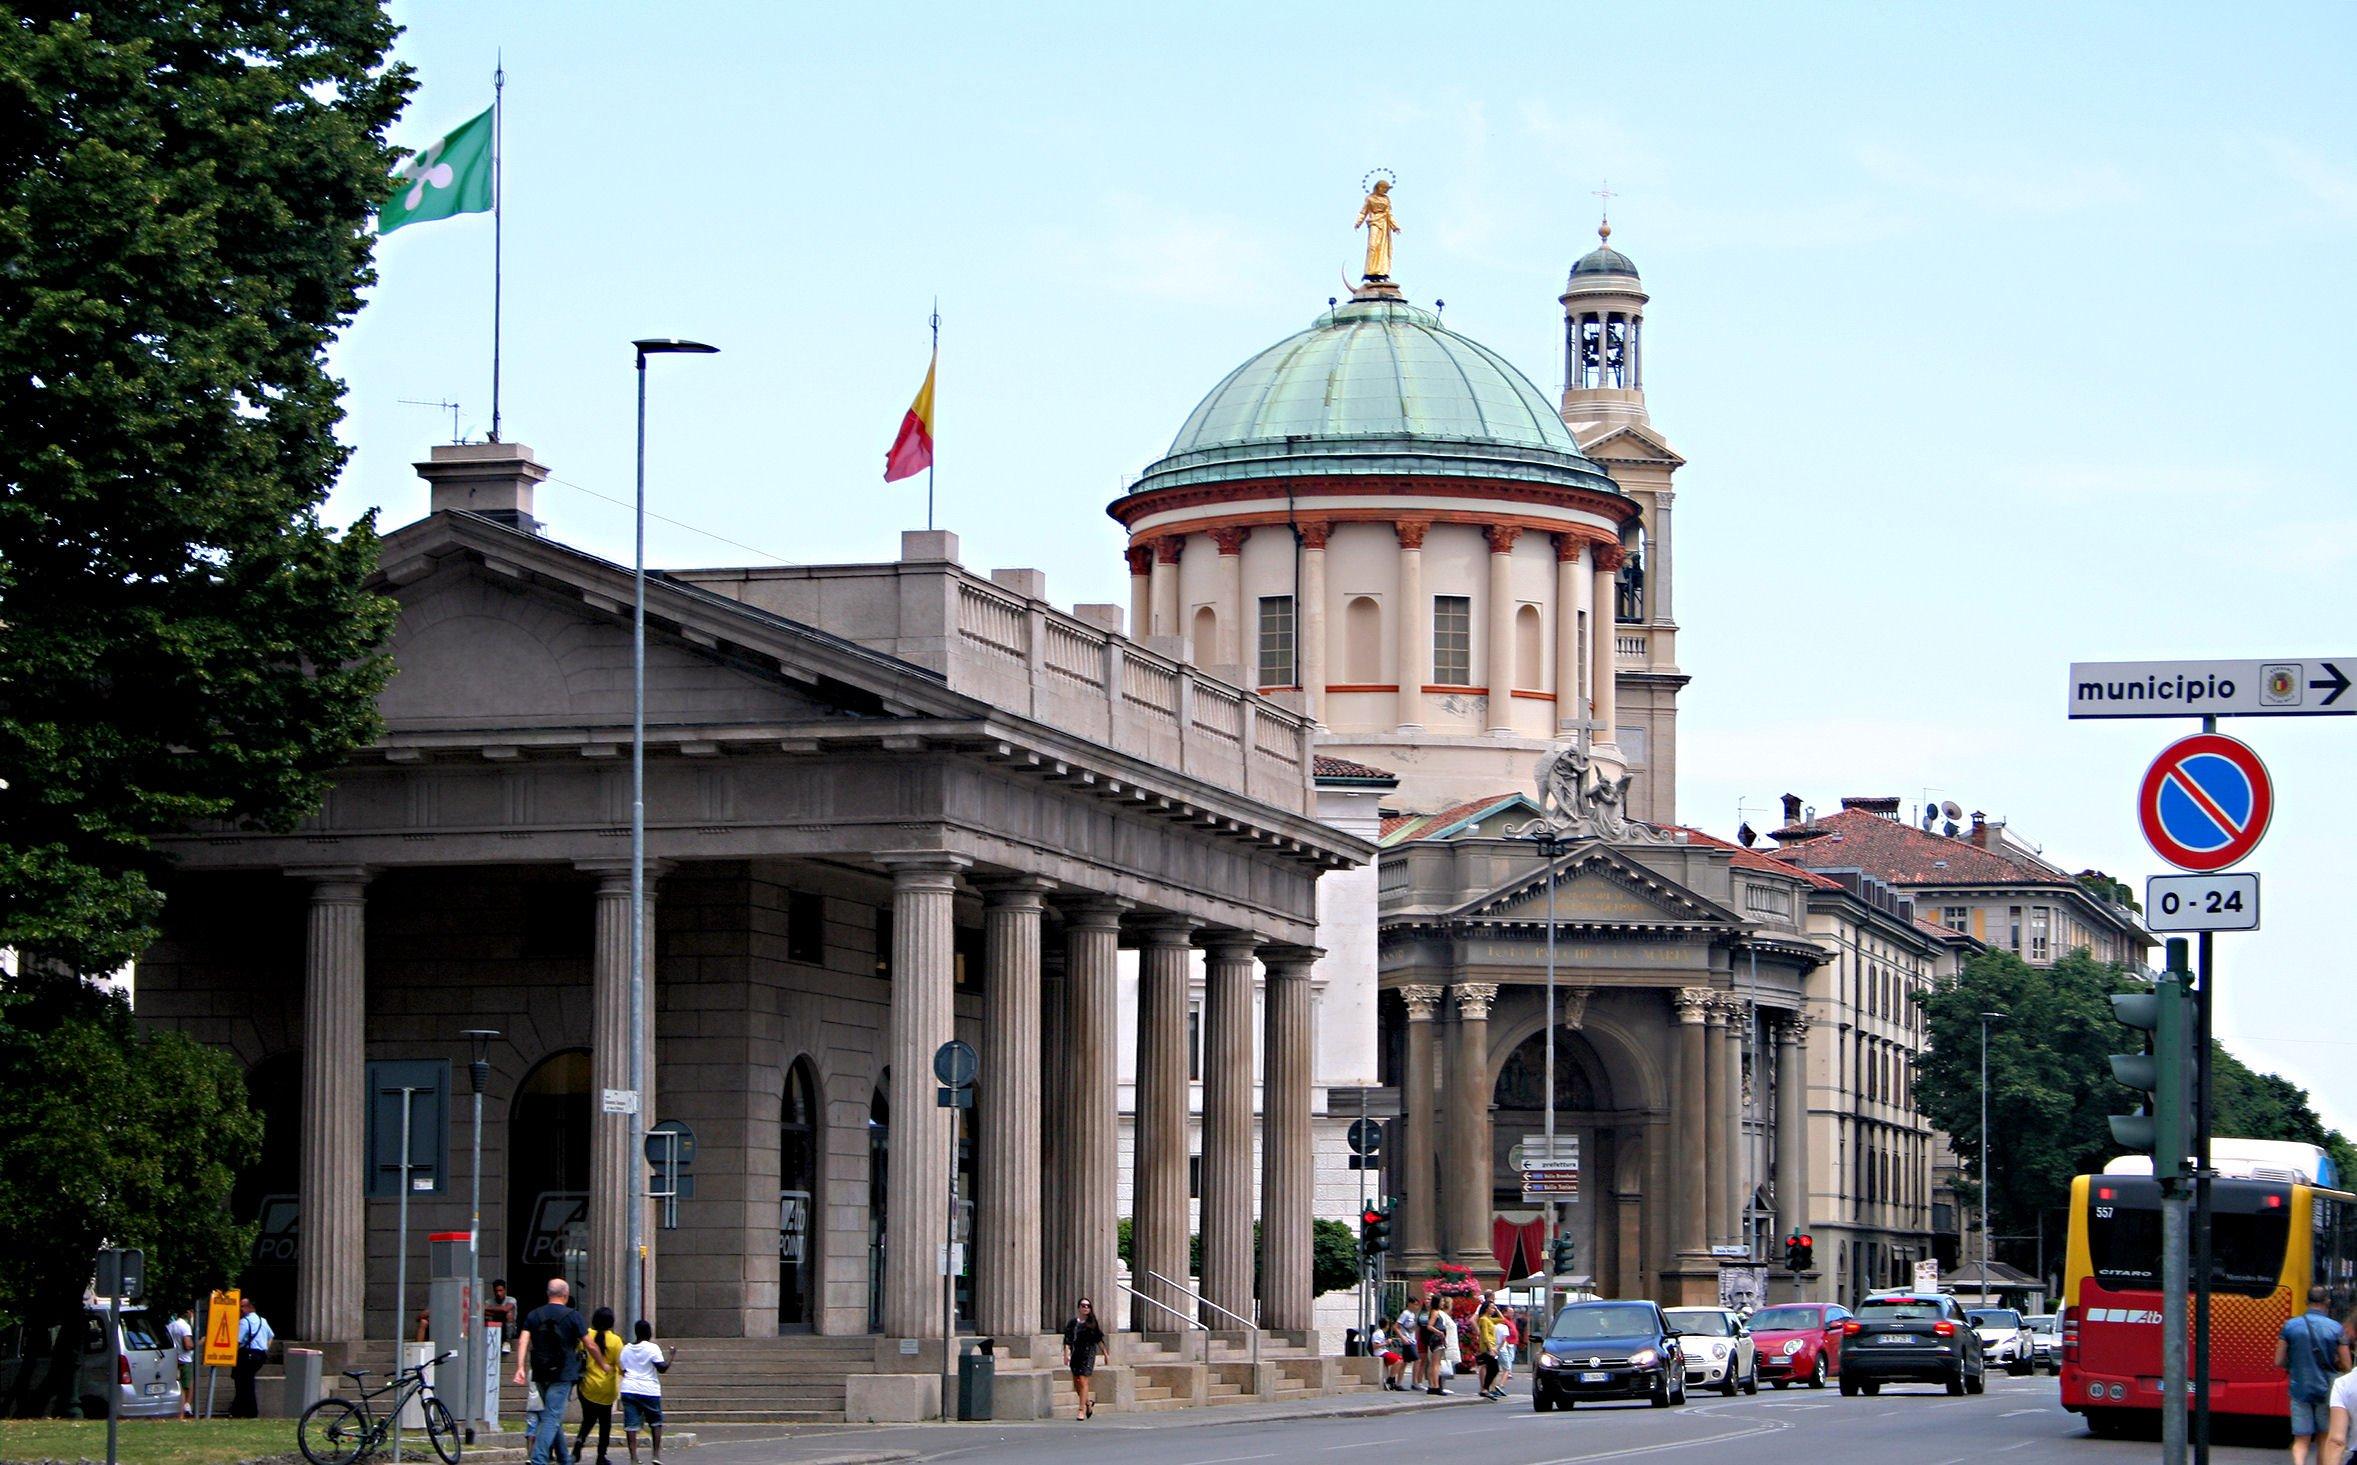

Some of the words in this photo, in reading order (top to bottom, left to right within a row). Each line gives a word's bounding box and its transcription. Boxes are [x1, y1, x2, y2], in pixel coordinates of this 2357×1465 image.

[2078, 674, 2235, 703] municipio
[2161, 892, 2179, 914] 0
[2206, 891, 2243, 913] 24
[2096, 1207, 2114, 1219] 557
[2098, 1269, 2153, 1277] CITARO
